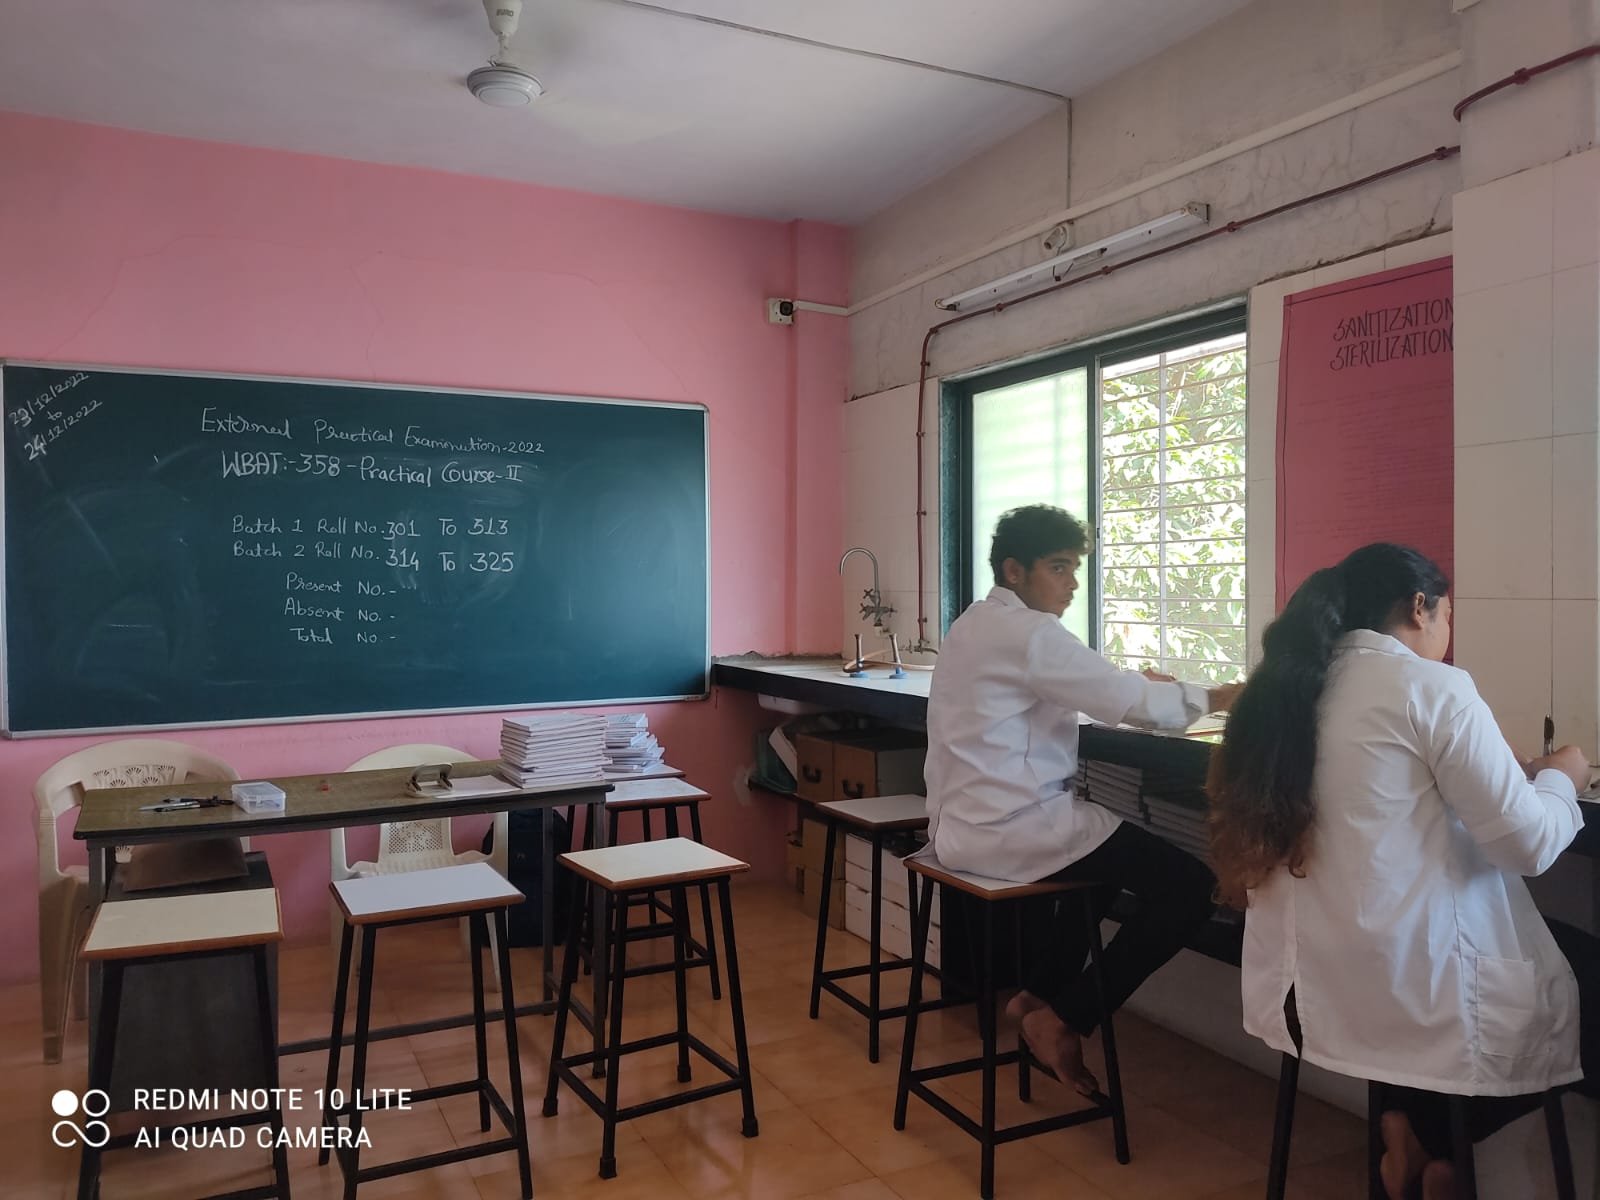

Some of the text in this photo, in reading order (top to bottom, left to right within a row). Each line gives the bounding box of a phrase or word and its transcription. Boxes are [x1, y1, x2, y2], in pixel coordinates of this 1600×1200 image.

[1330, 323, 1453, 371] STERILIZATION
[47, 410, 63, 421] to
[24, 400, 103, 460] 24/12/2022
[232, 514, 282, 534] Batch
[291, 519, 304, 533] 1
[317, 516, 347, 535] Roll
[438, 518, 457, 536] To
[467, 517, 509, 536] 313
[233, 539, 282, 557] Batch
[293, 544, 305, 557] 2
[315, 540, 341, 558] Roll
[385, 547, 420, 571] 314
[438, 551, 456, 572] To
[469, 551, 515, 573] 325
[286, 571, 343, 593] Present
[284, 596, 345, 622] Absent
[289, 627, 334, 645] Total
